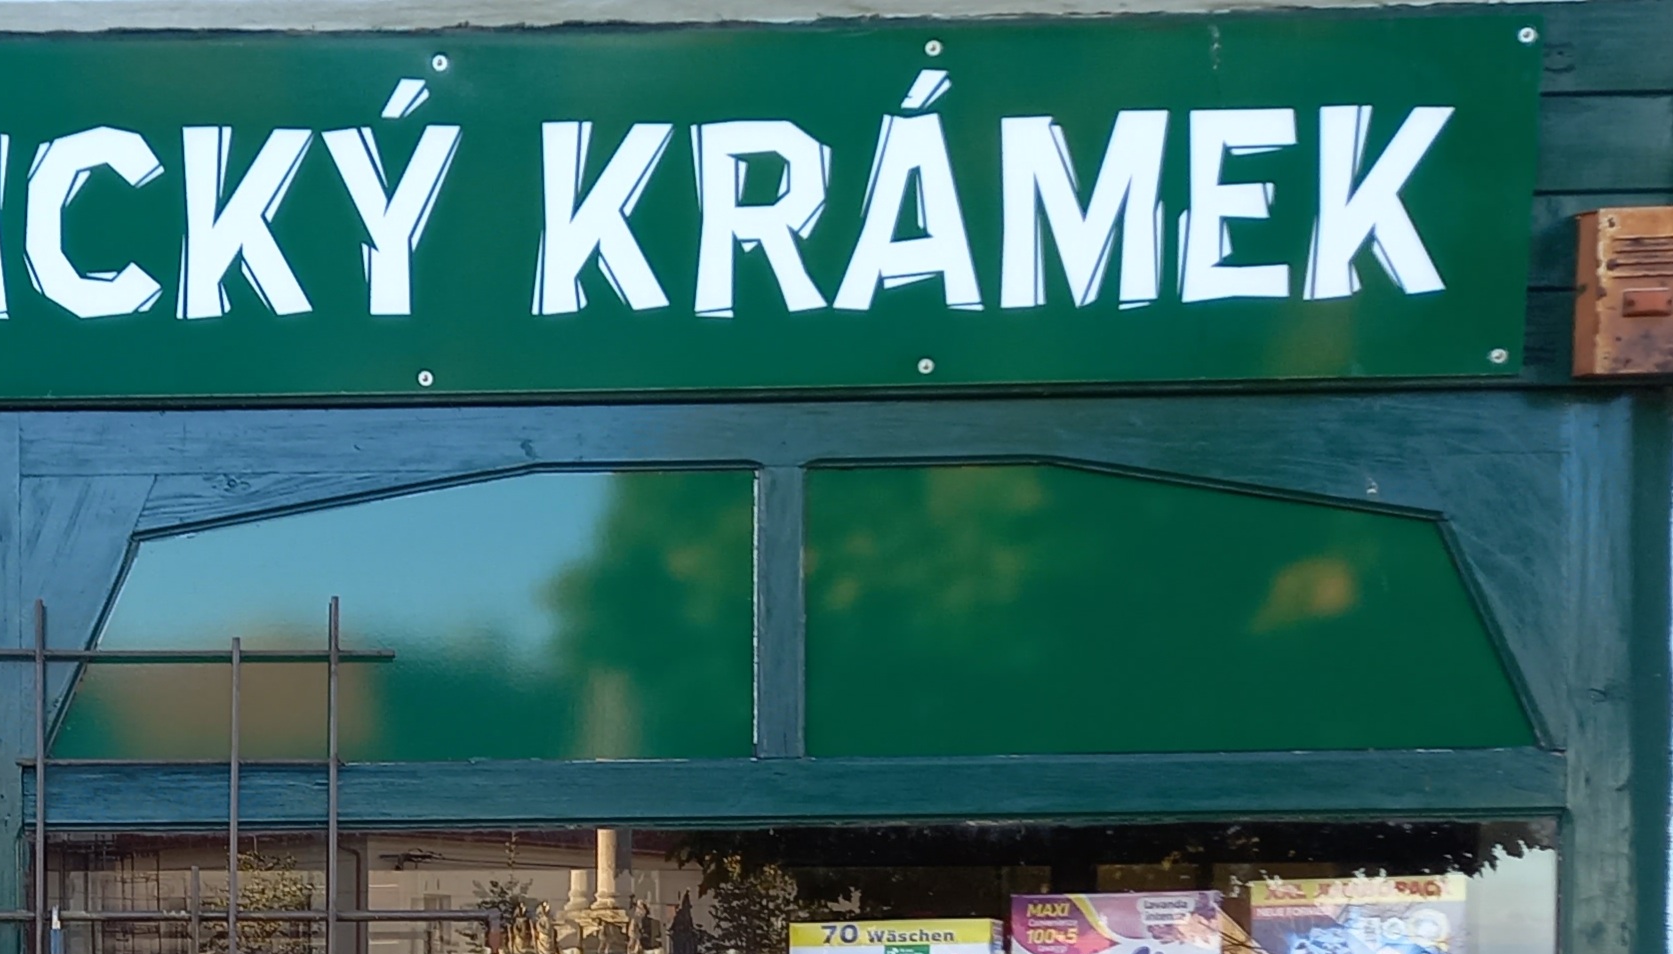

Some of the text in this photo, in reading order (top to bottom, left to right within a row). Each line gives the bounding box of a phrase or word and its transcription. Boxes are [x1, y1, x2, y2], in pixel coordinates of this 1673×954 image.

[531, 68, 1456, 319] KRÁMEK
[1026, 903, 1070, 917] MAXI
[821, 924, 955, 944] 70 Wäschen
